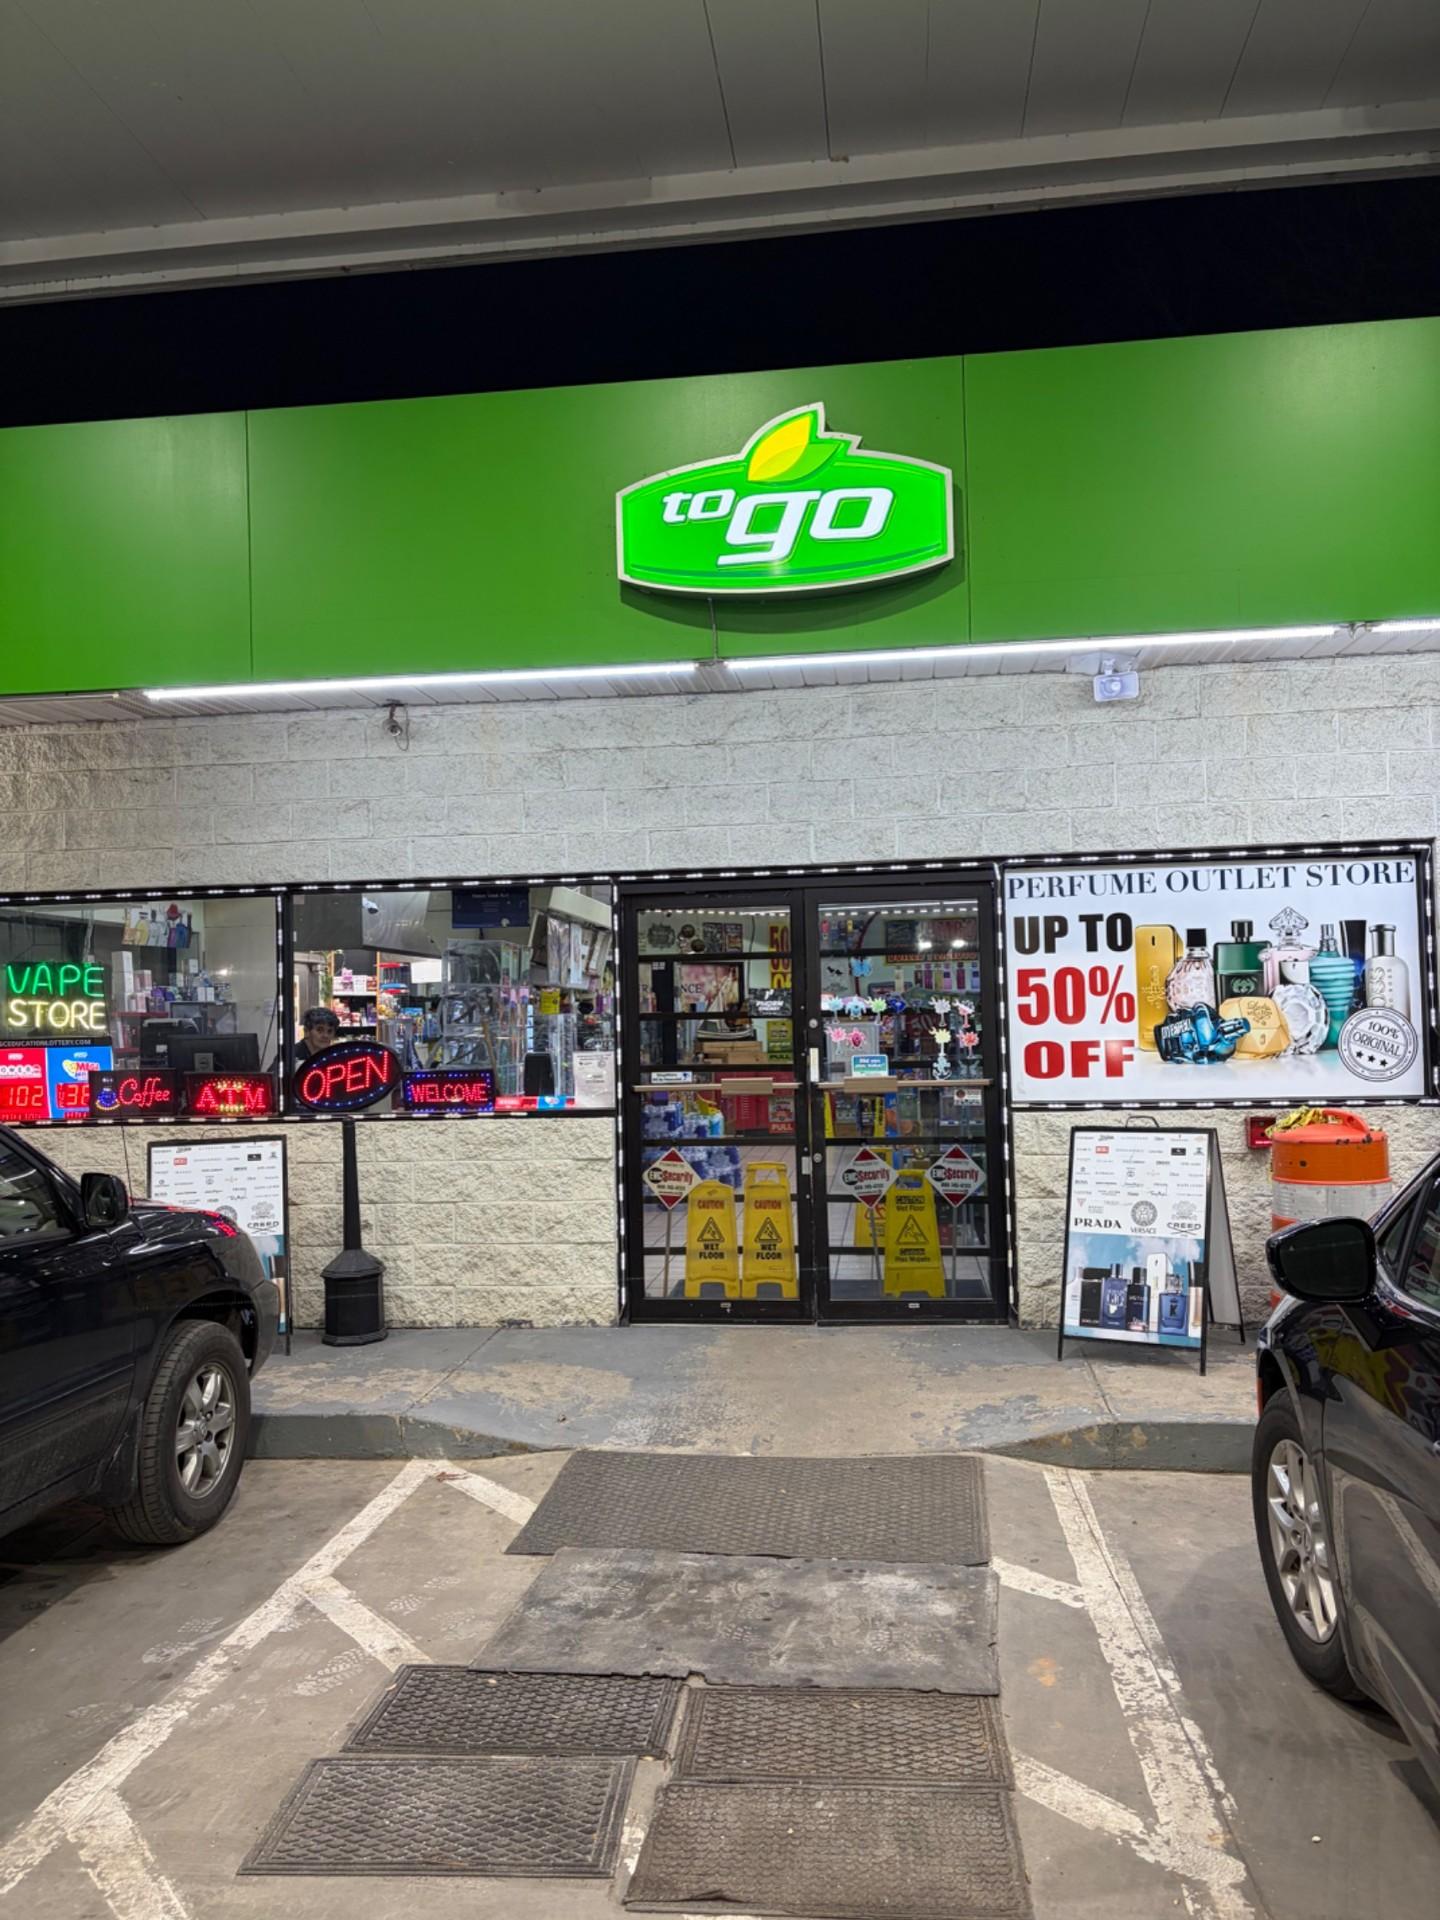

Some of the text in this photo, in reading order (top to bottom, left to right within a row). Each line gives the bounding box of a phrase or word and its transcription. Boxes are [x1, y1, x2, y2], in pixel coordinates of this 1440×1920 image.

[662, 487, 894, 566] to go
[1008, 860, 1414, 899] PERFUME OUTLET STORE
[1013, 915, 1068, 955] UP
[1079, 912, 1133, 952] TO
[7, 964, 105, 997] VAPE
[1016, 964, 1136, 1026] 50%
[8, 999, 106, 1030] STORE
[1367, 1021, 1400, 1040] 100%
[1352, 1031, 1401, 1056] ORIGINAL
[1023, 1038, 1136, 1079] OFF
[303, 1050, 388, 1102] OPEN
[9, 1085, 43, 1107] 102
[119, 1078, 170, 1107] Coffee
[197, 1086, 265, 1109] ATM
[411, 1083, 488, 1103] WELCOME
[662, 1170, 694, 1185] Security
[857, 1168, 890, 1182] Security
[945, 1167, 979, 1181] Security
[697, 1200, 725, 1209] CAUTION
[754, 1200, 782, 1209] CAUTION
[247, 1221, 279, 1229] CREED
[1074, 1217, 1122, 1229] PRADA
[1166, 1222, 1202, 1230] CREED
[699, 1252, 725, 1260] FLOOR
[756, 1252, 782, 1260] FLOOR
